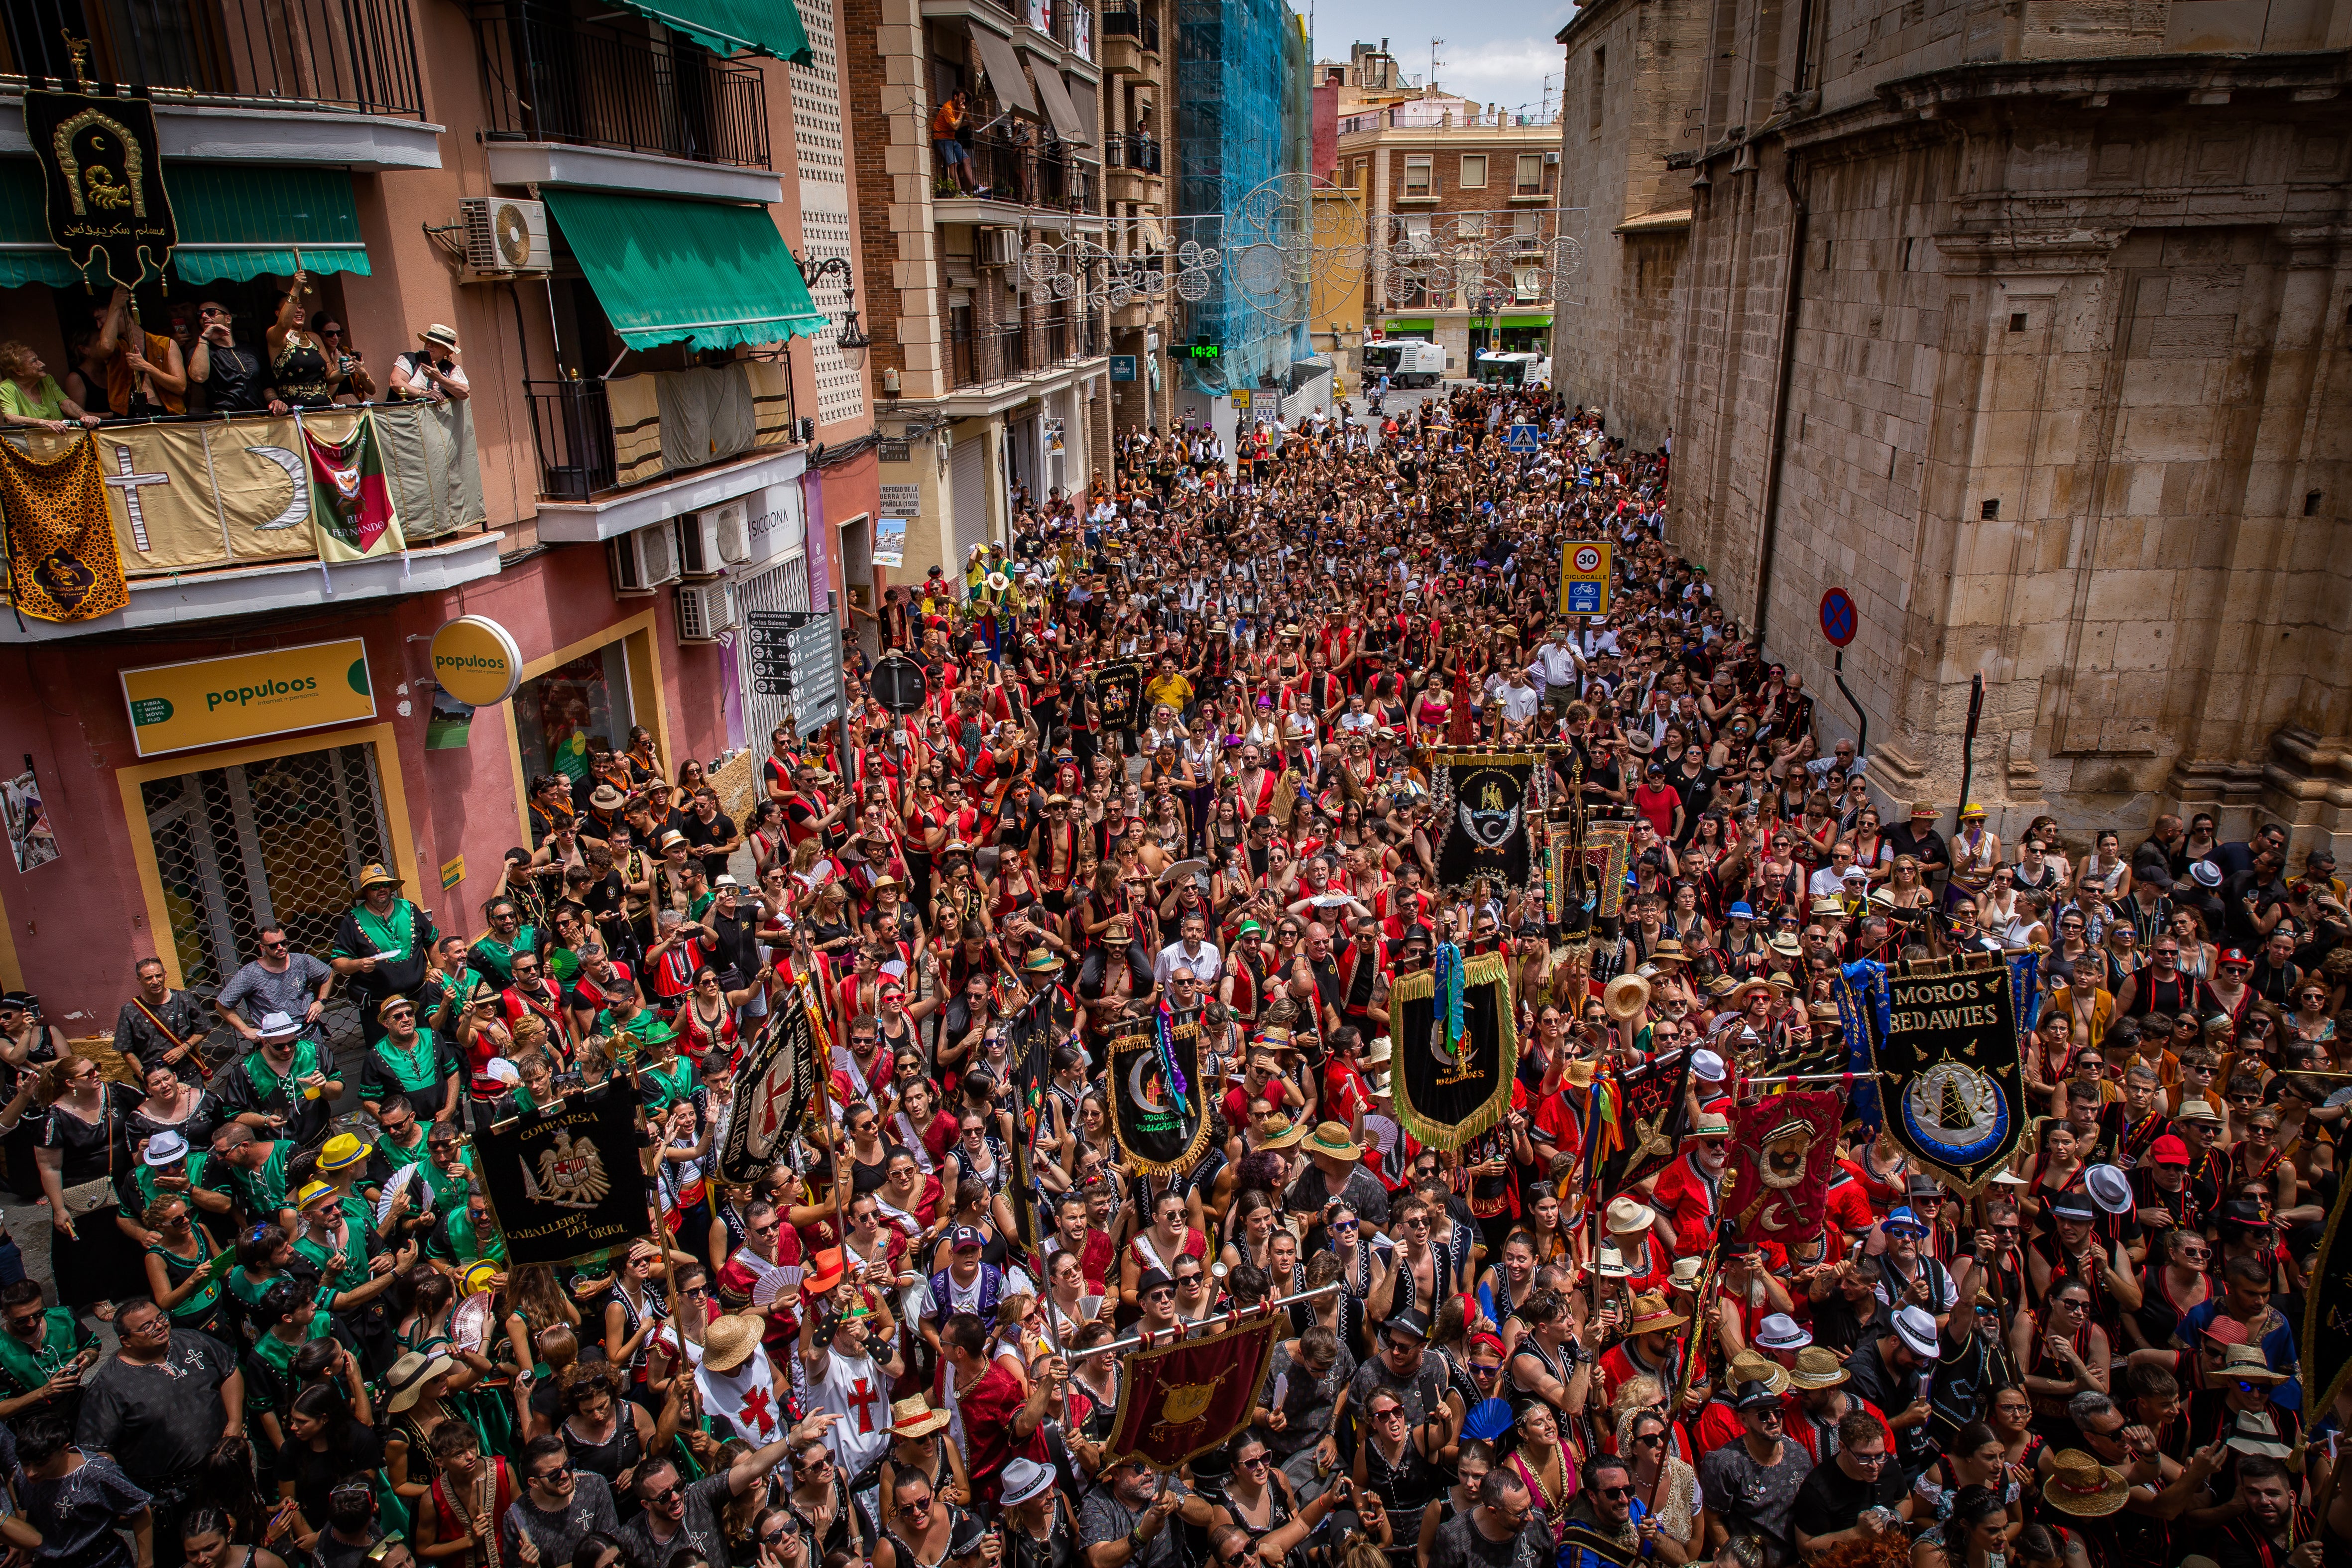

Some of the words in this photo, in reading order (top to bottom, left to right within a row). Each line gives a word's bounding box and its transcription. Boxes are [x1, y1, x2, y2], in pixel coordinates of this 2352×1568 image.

[347, 513, 363, 524] REY
[752, 508, 789, 537] SICCIONA
[332, 521, 385, 537] FERNANDO
[812, 554, 825, 566] SICCIONA
[1578, 554, 1596, 565] 30
[820, 618, 830, 627] museo
[813, 642, 832, 654] Reconquista
[822, 652, 832, 661] iglesia
[436, 655, 504, 671] populoos
[565, 658, 595, 669] IBRA
[808, 666, 821, 676] Santiago
[822, 659, 833, 670] Apóstol
[819, 670, 834, 681] santuario
[816, 678, 834, 691] Monserrate
[206, 677, 317, 712] populoos
[257, 697, 284, 706] internet
[289, 692, 319, 702] personas
[807, 696, 819, 707] palacio
[819, 687, 835, 701] Rubalcava
[798, 724, 807, 733] OTROS
[807, 713, 826, 728] MONUMENTOS
[1459, 768, 1483, 791] MOROS
[443, 861, 463, 877] populoos
[1464, 866, 1509, 889] ORIHUEL
[1894, 980, 1980, 1005] MOROS
[1890, 1004, 1998, 1033] BEDAWIES
[795, 1010, 812, 1099] TEMPLARIOS
[520, 1111, 599, 1141] COMPARSA
[725, 1084, 750, 1164] CABALLEROS
[744, 1130, 792, 1179] ORIHUELA
[506, 1210, 587, 1239] CABALLEROS
[566, 1220, 593, 1239] DEL
[588, 1223, 628, 1240] ORIOL
